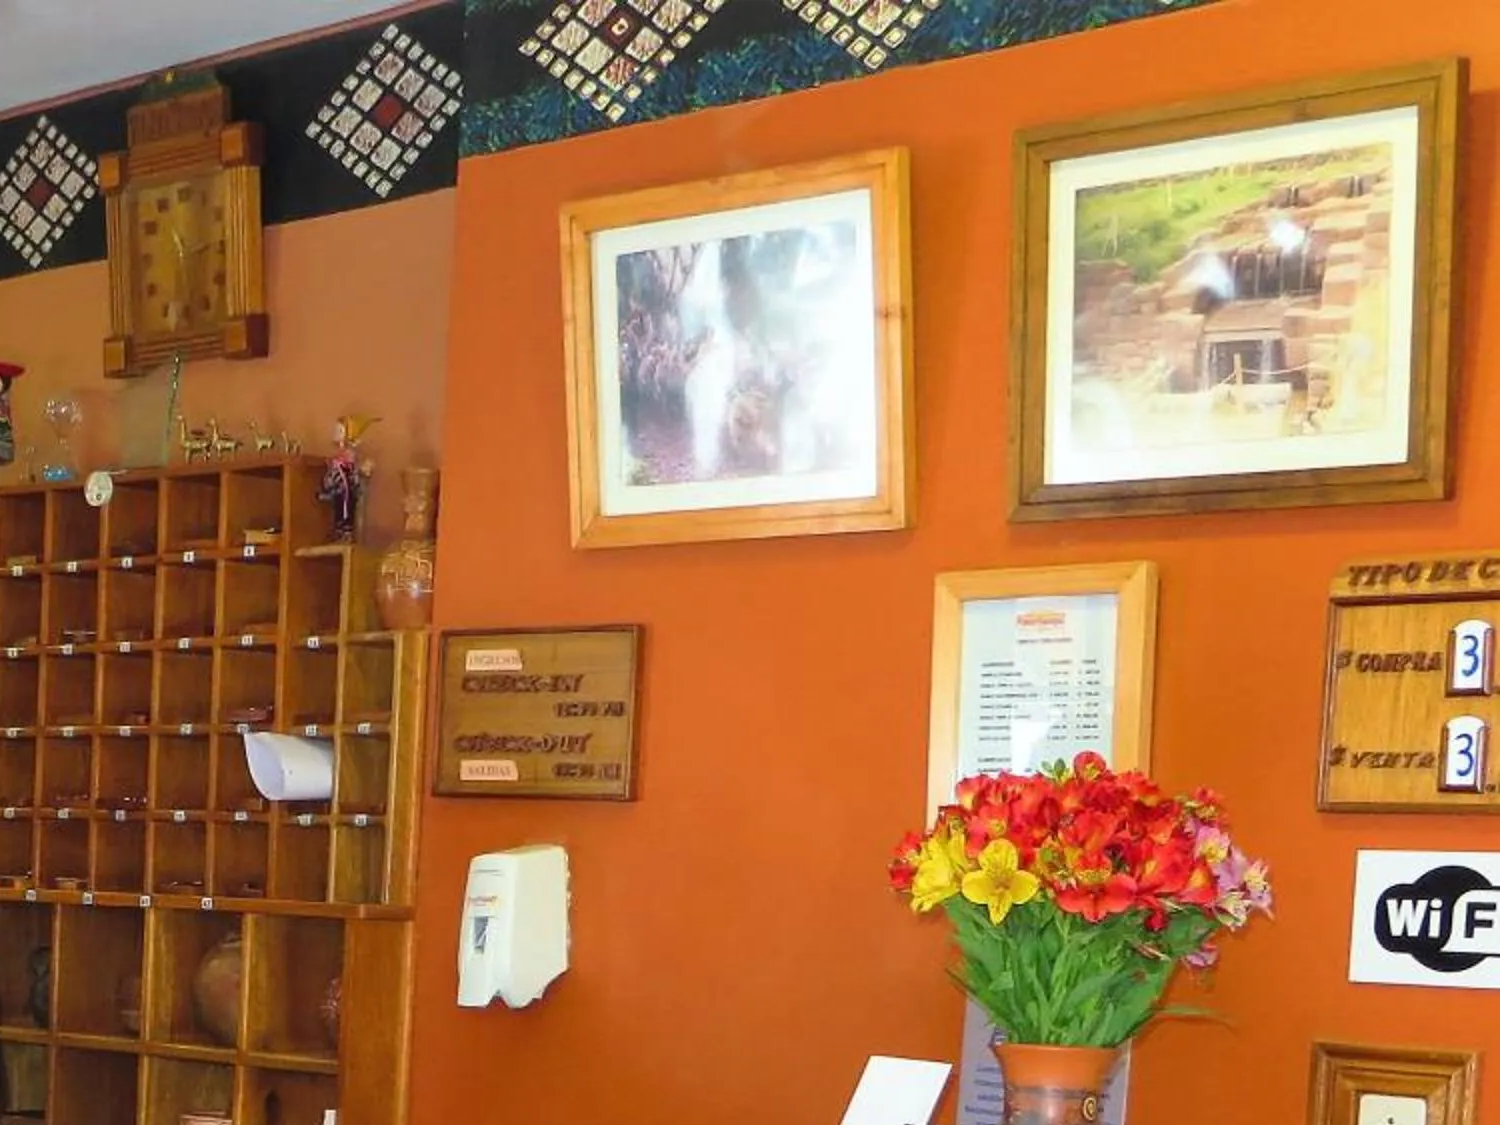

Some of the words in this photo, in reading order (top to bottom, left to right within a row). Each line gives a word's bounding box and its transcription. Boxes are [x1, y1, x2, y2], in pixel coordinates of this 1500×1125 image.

[1348, 562, 1421, 586] TIPO
[1428, 560, 1476, 582] DE
[1357, 652, 1444, 673] COMPRA
[1351, 751, 1436, 769] VENTA
